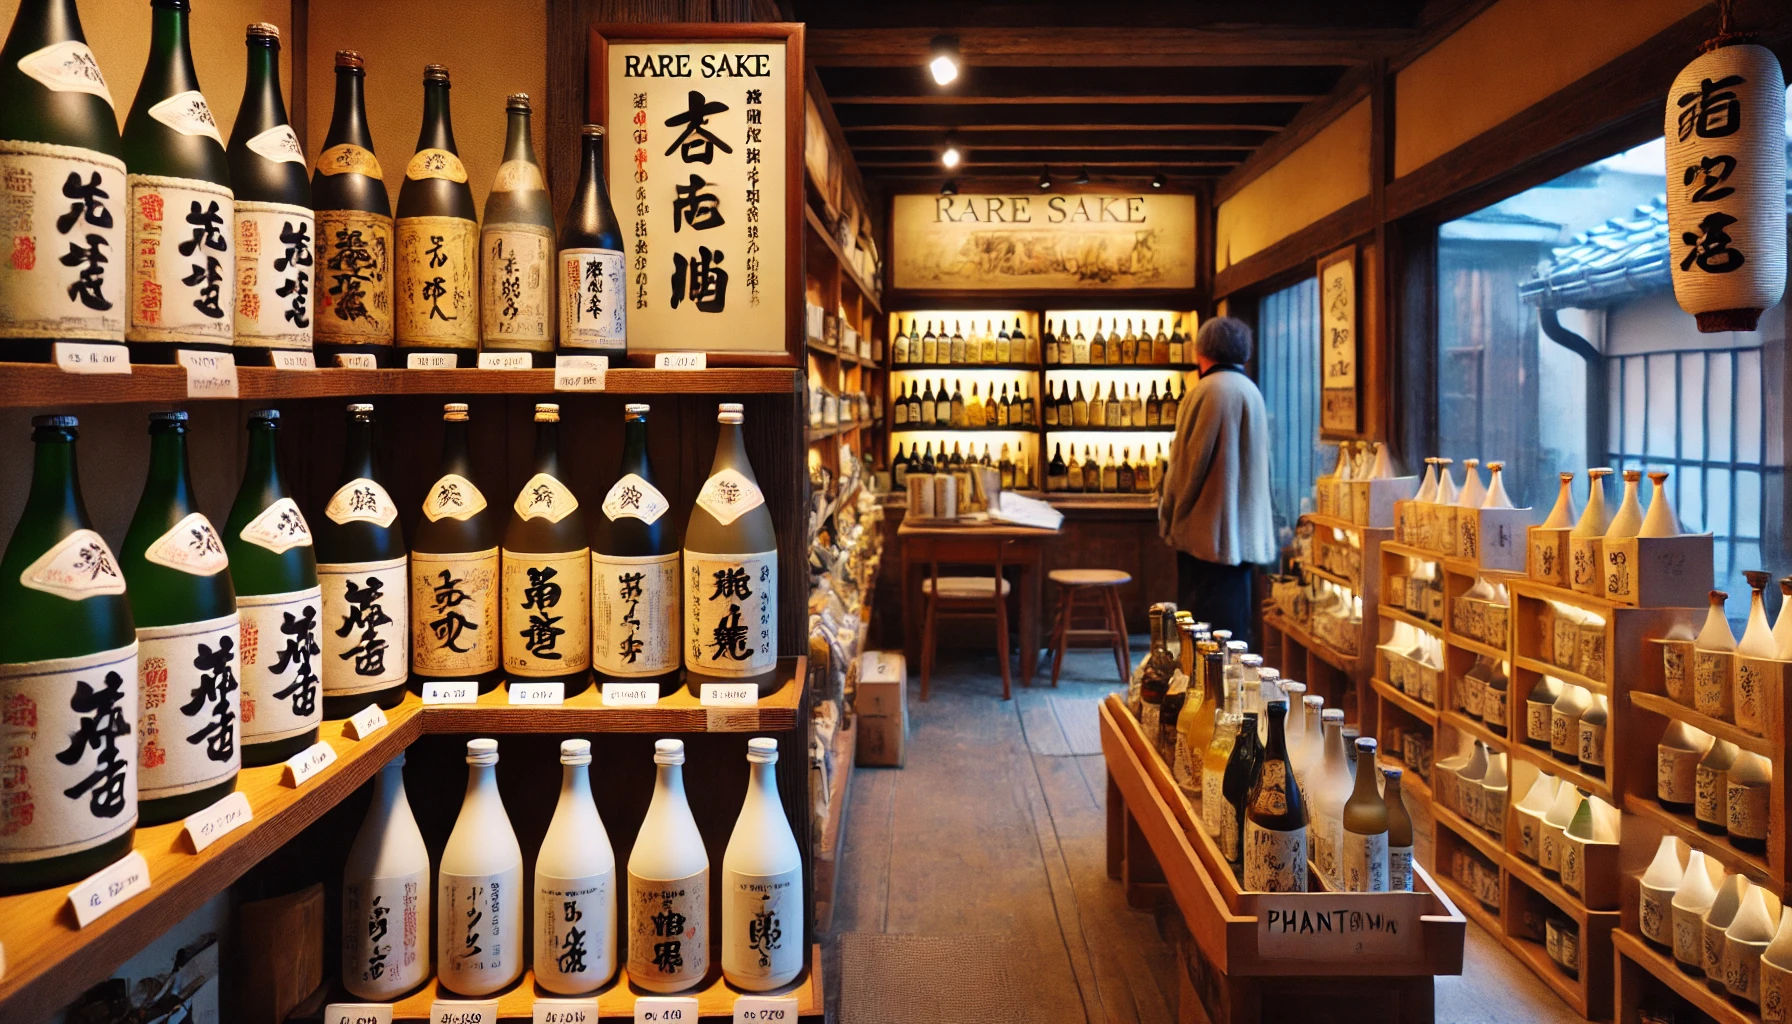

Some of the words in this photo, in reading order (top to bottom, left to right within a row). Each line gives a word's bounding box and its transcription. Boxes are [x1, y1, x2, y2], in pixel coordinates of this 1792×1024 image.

[625, 54, 692, 78] RARE
[701, 54, 771, 79] SAKE
[933, 196, 1031, 223] RARE
[1048, 196, 1146, 223] SAKE
